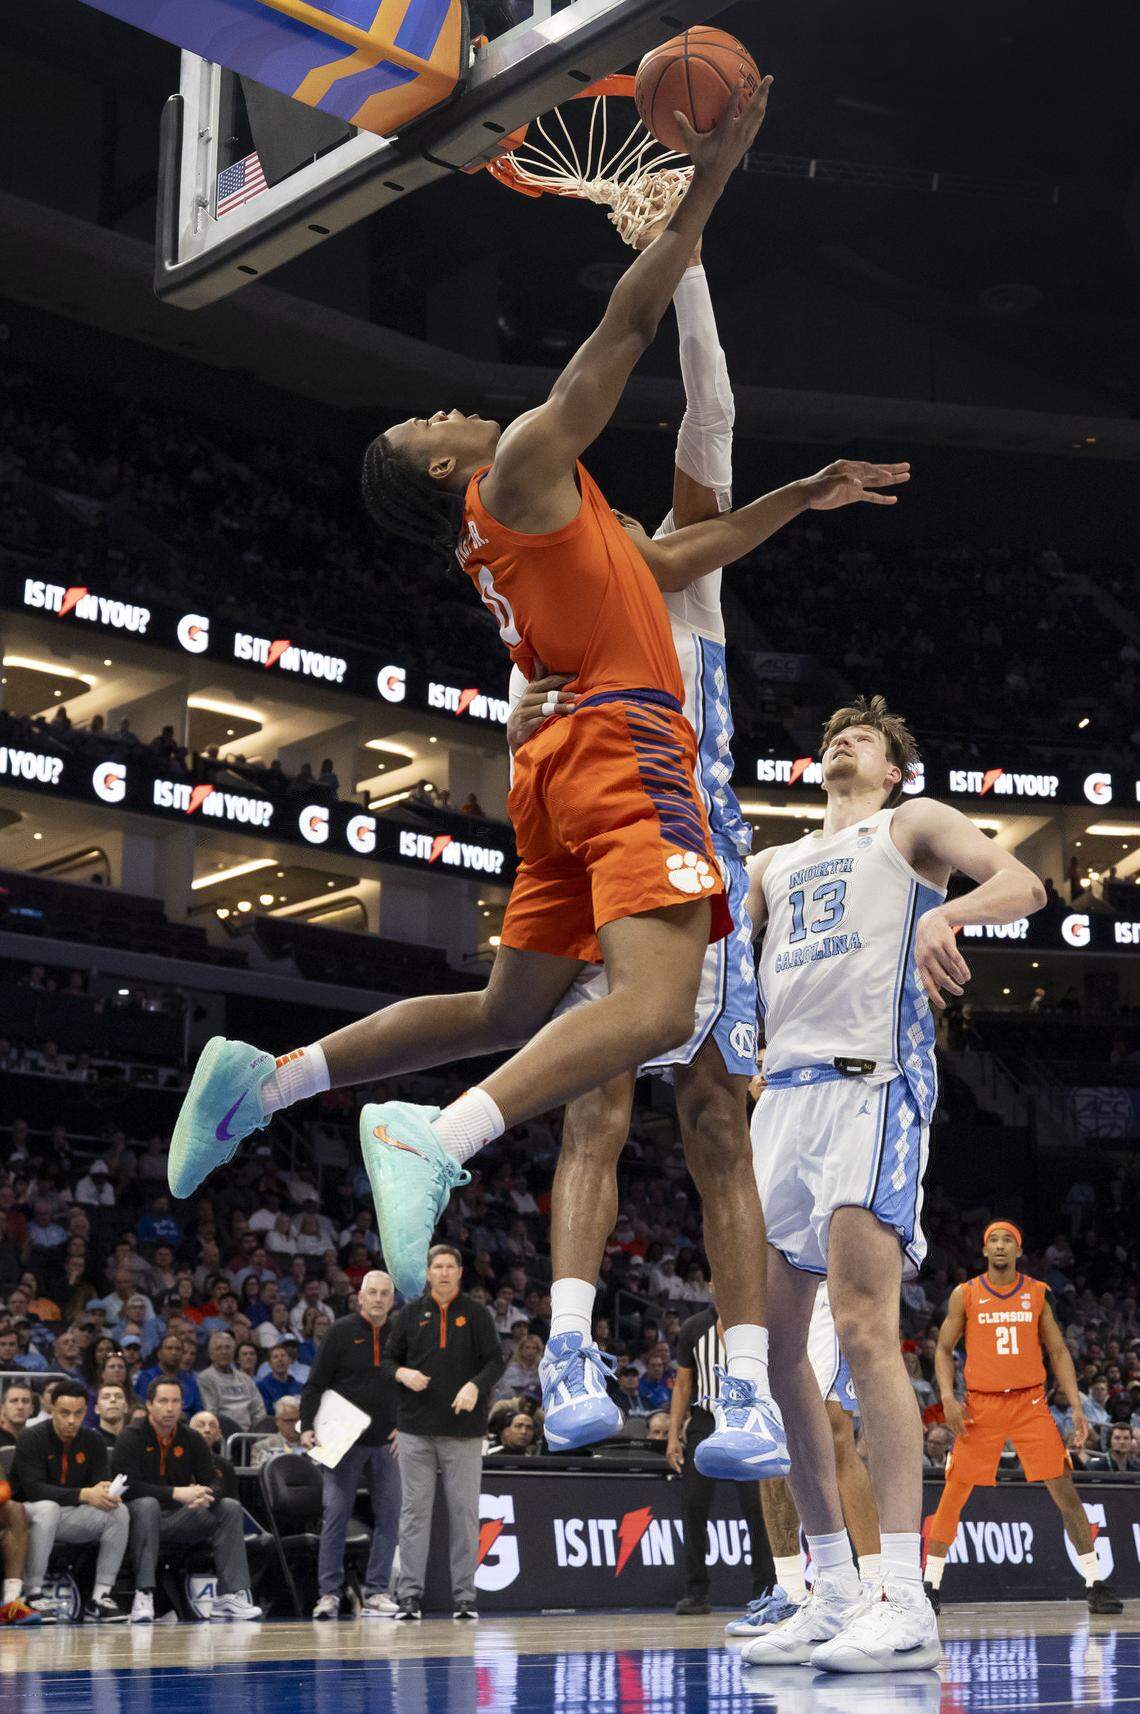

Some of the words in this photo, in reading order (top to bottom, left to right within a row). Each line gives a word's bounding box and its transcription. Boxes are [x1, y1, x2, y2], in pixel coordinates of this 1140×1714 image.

[177, 614, 209, 653] G
[377, 665, 406, 702] G
[487, 697, 510, 724] YO
[8, 748, 64, 785] YOU?
[92, 761, 127, 803] G
[1083, 772, 1113, 805] G
[299, 805, 329, 844] G
[346, 814, 377, 853] G
[788, 857, 854, 890] NORTH
[788, 879, 847, 945] 13
[1061, 913, 1091, 947] G
[775, 931, 863, 973] CAROLINA
[977, 1310, 1033, 1325] CLEMSON
[995, 1326, 1019, 1356] 21
[473, 1493, 520, 1592] G
[966, 1521, 1034, 1565] YOU?
